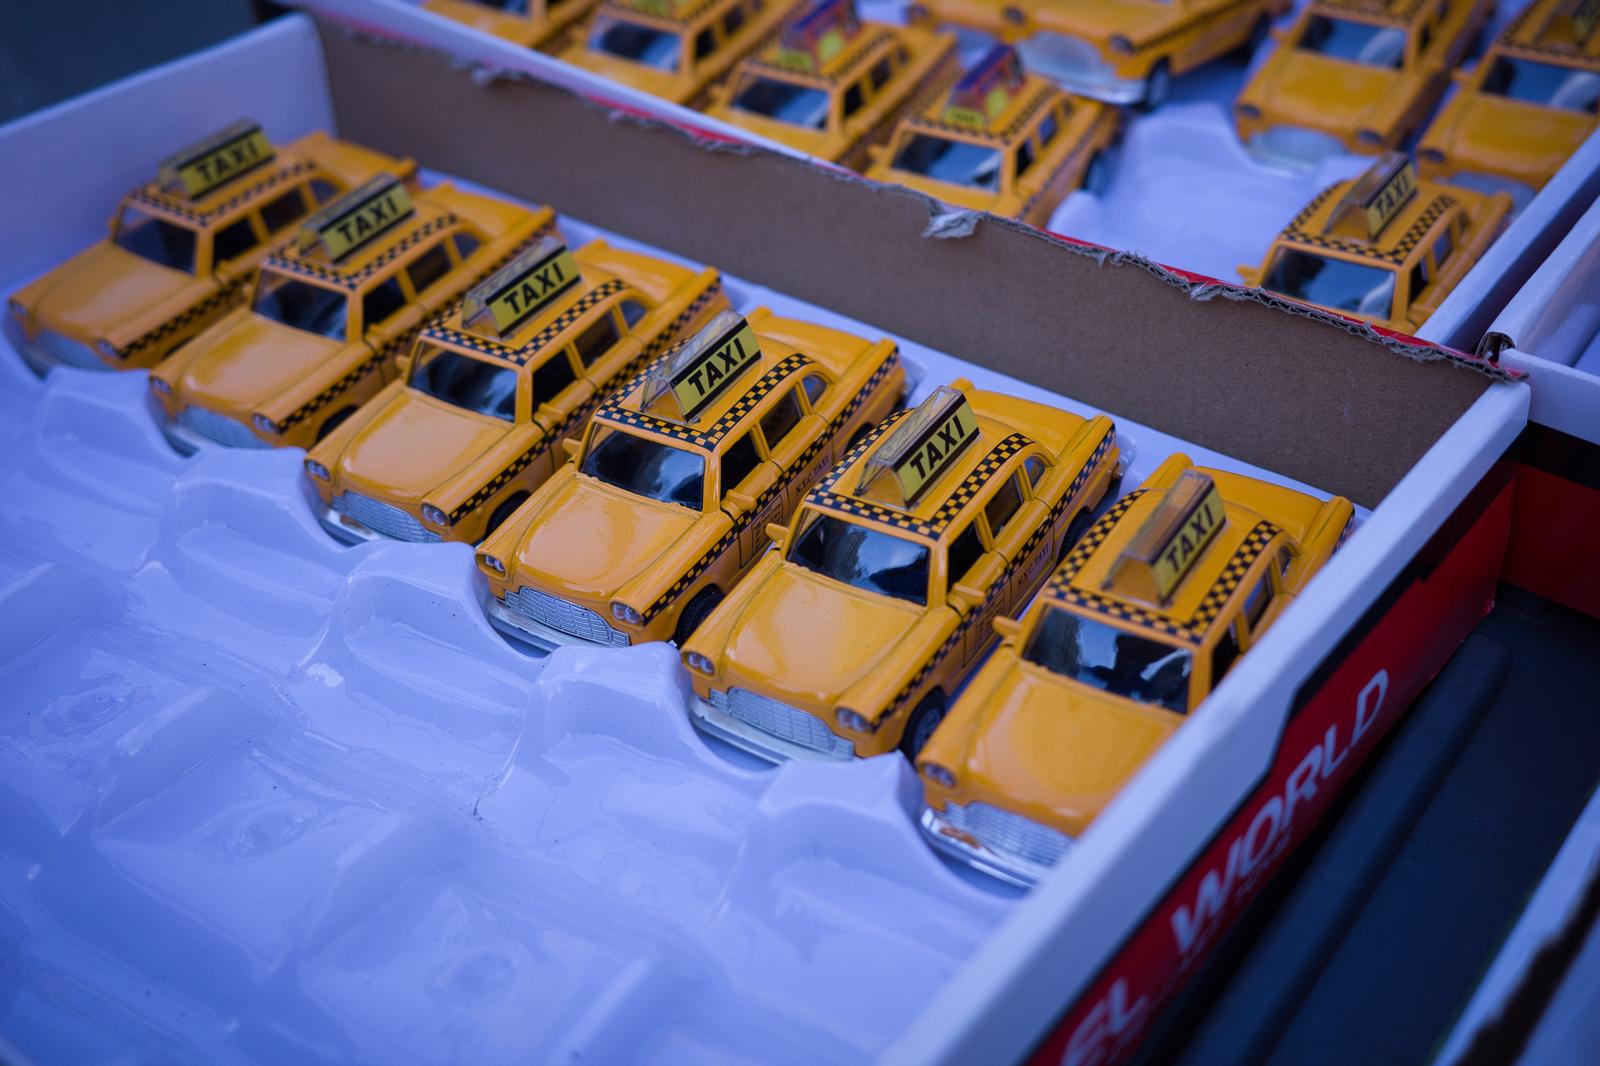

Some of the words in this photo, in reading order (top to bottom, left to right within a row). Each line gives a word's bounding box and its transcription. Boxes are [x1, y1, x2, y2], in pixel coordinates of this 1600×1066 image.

[196, 140, 260, 186] TAXI
[338, 195, 400, 245] TAXI
[1376, 171, 1409, 220] TAXI
[504, 261, 566, 316] TAXI
[688, 335, 744, 397] TAXI
[910, 414, 966, 480] TAXI
[1166, 504, 1215, 573] TAXI
[1170, 668, 1389, 955] WORLD
